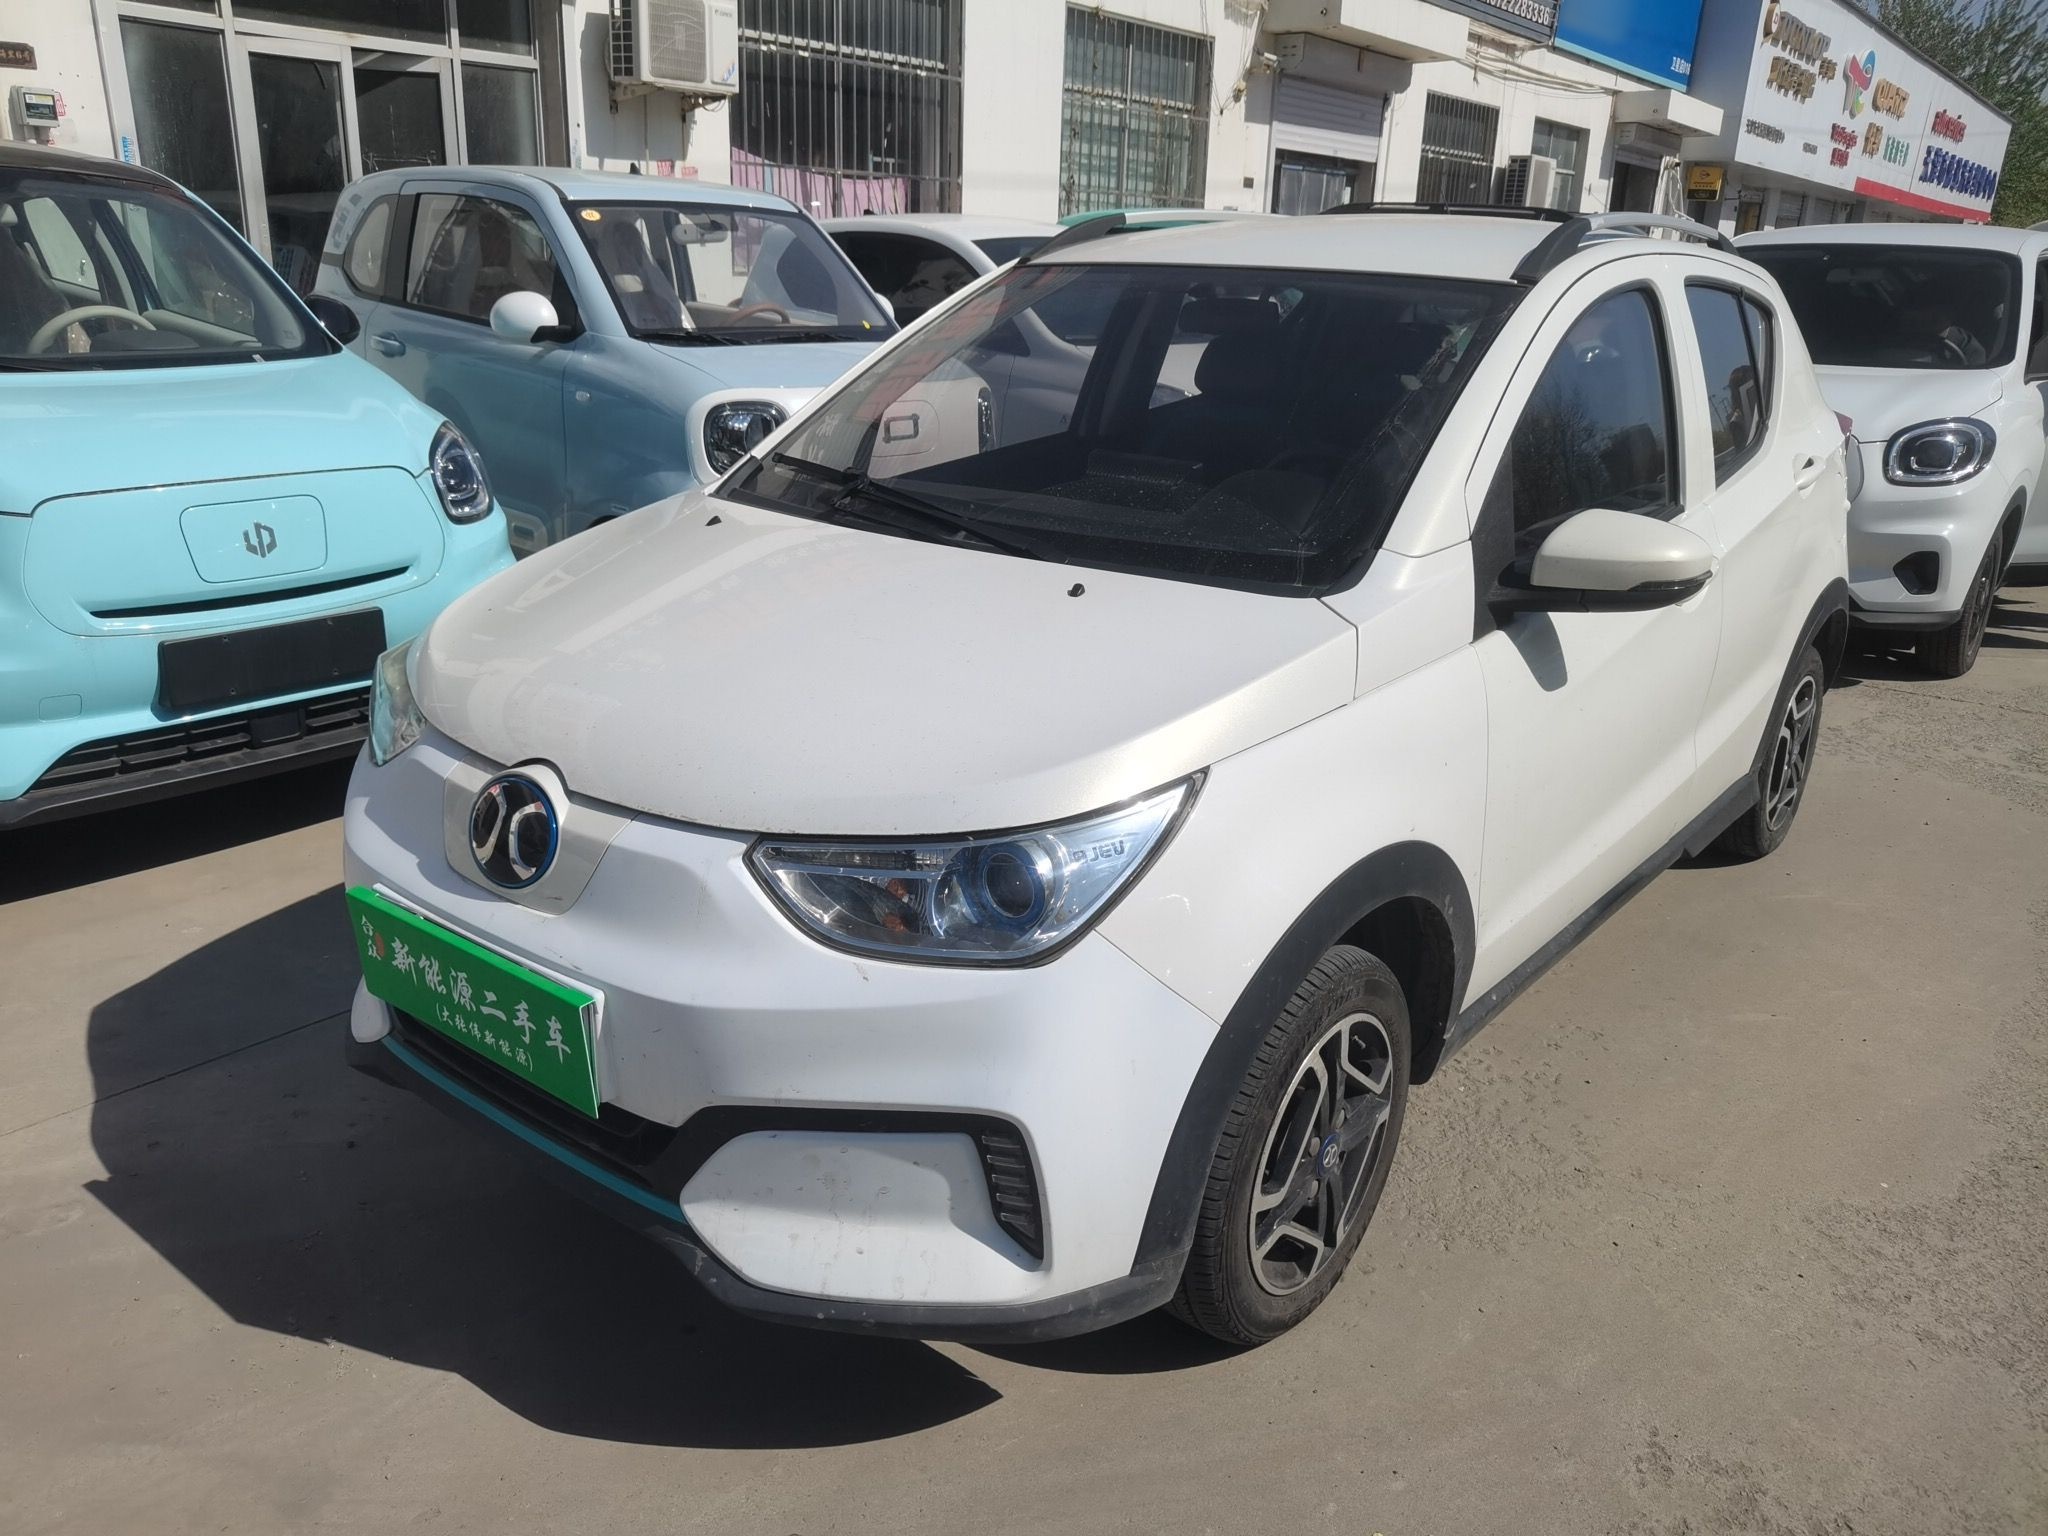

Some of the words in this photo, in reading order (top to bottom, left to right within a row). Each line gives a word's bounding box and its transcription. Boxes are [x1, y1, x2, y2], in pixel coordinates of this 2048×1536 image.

[391, 936, 572, 1065] 新能源二手车
